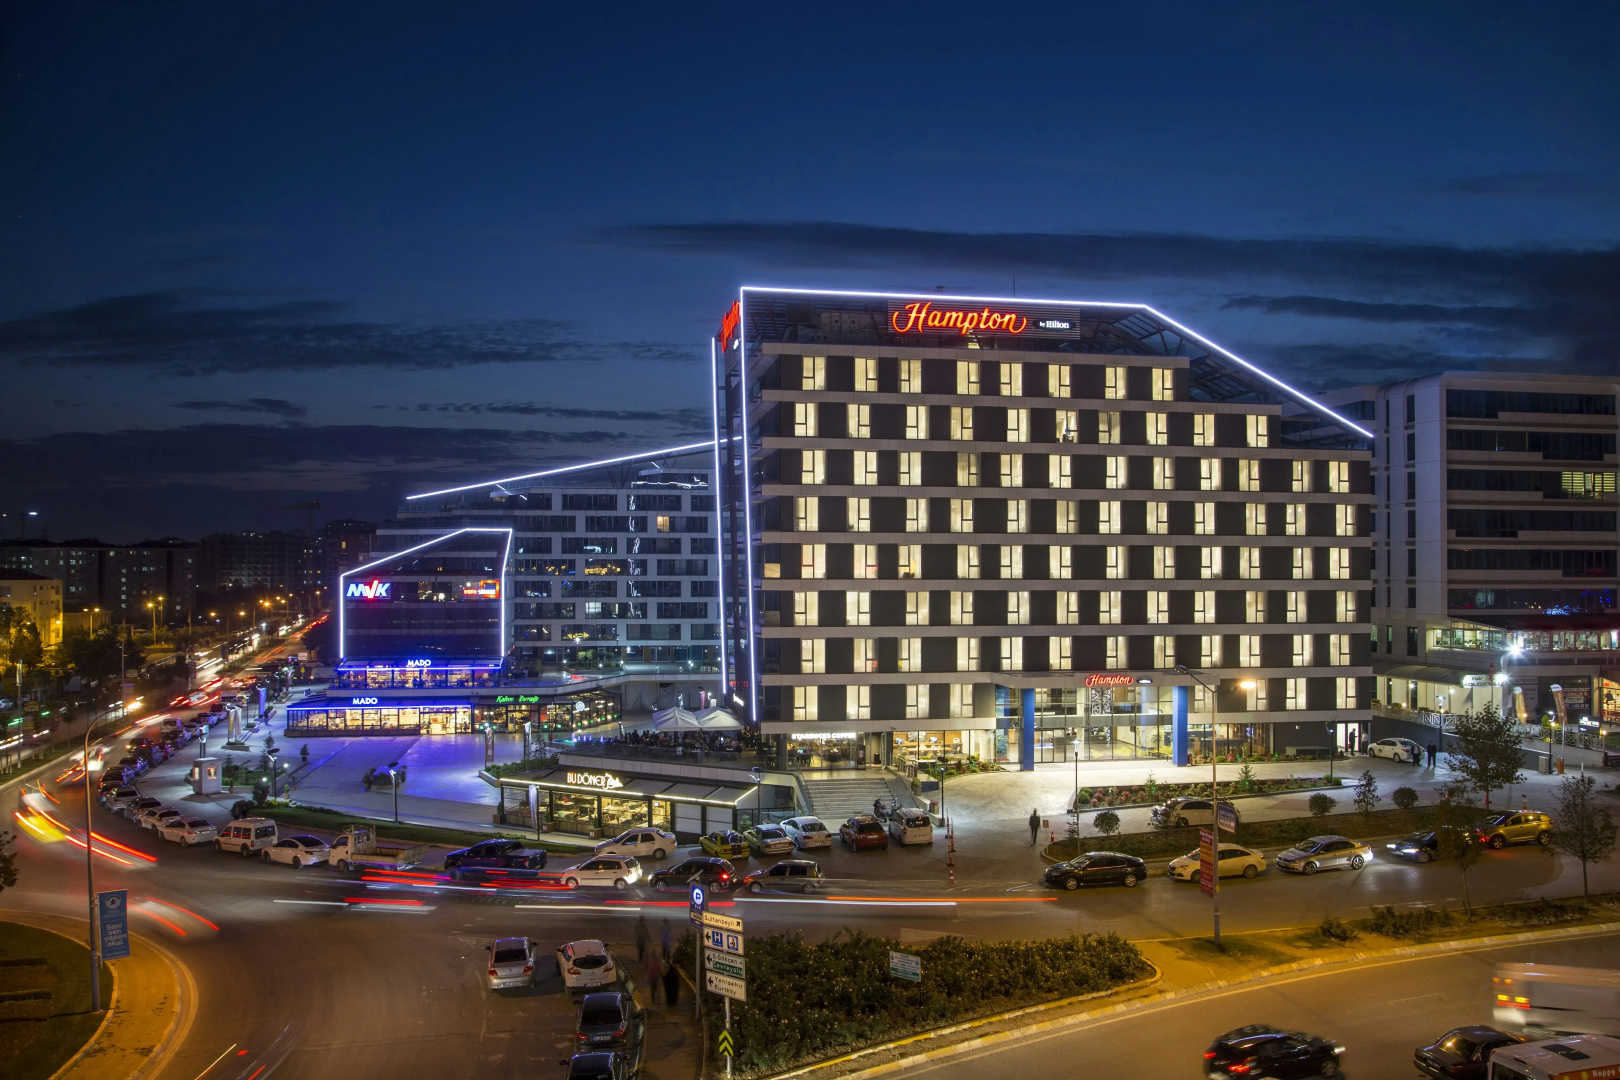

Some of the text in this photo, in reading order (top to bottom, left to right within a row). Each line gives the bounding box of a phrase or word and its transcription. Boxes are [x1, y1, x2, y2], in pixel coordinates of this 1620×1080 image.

[892, 301, 1027, 335] Hampton
[1045, 320, 1070, 329] Hilton
[407, 659, 432, 667] MADO
[1085, 673, 1134, 687] Hampton
[352, 697, 378, 705] MADO
[567, 772, 606, 787] BU DÖNER
[704, 914, 735, 927] Sultanbeyli
[106, 922, 123, 930] Seni
[104, 934, 127, 942] yapan
[1592, 1069, 1616, 1078] Happy
